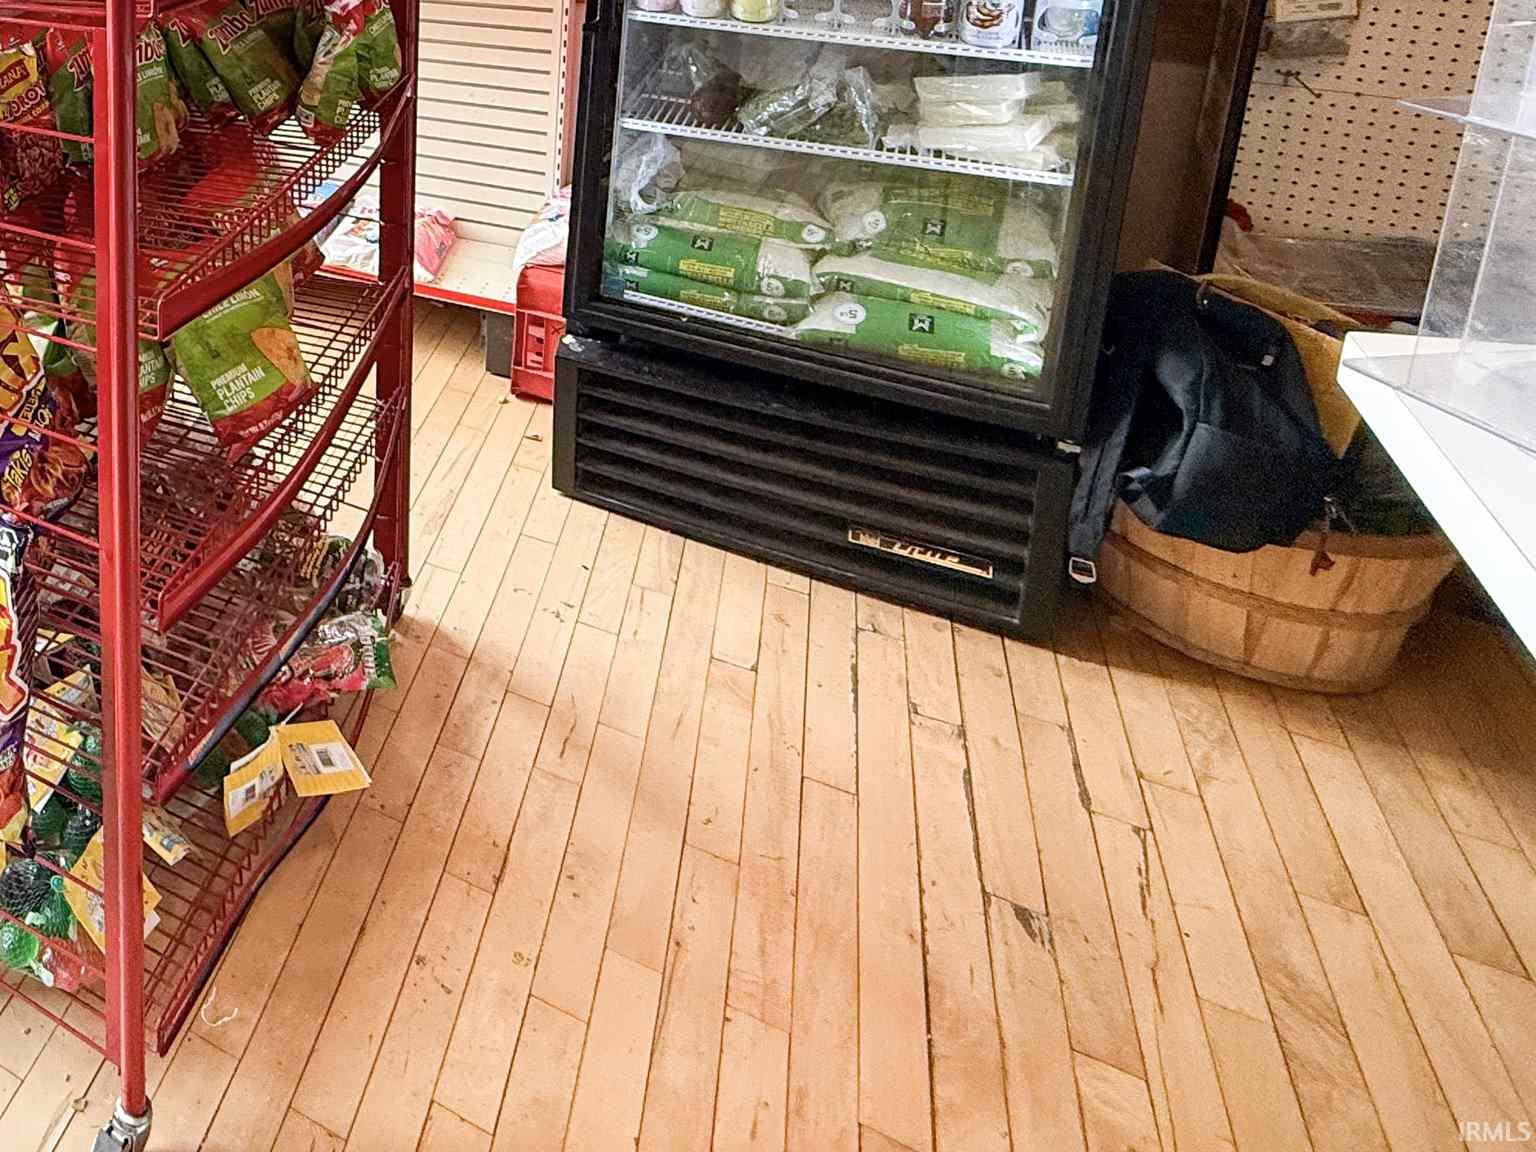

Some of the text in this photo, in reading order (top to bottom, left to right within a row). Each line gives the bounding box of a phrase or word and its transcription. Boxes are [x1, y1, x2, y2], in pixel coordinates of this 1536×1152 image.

[216, 365, 266, 401] PLANTAIN
[222, 387, 257, 412] CHIPS
[4, 448, 35, 493] Takis
